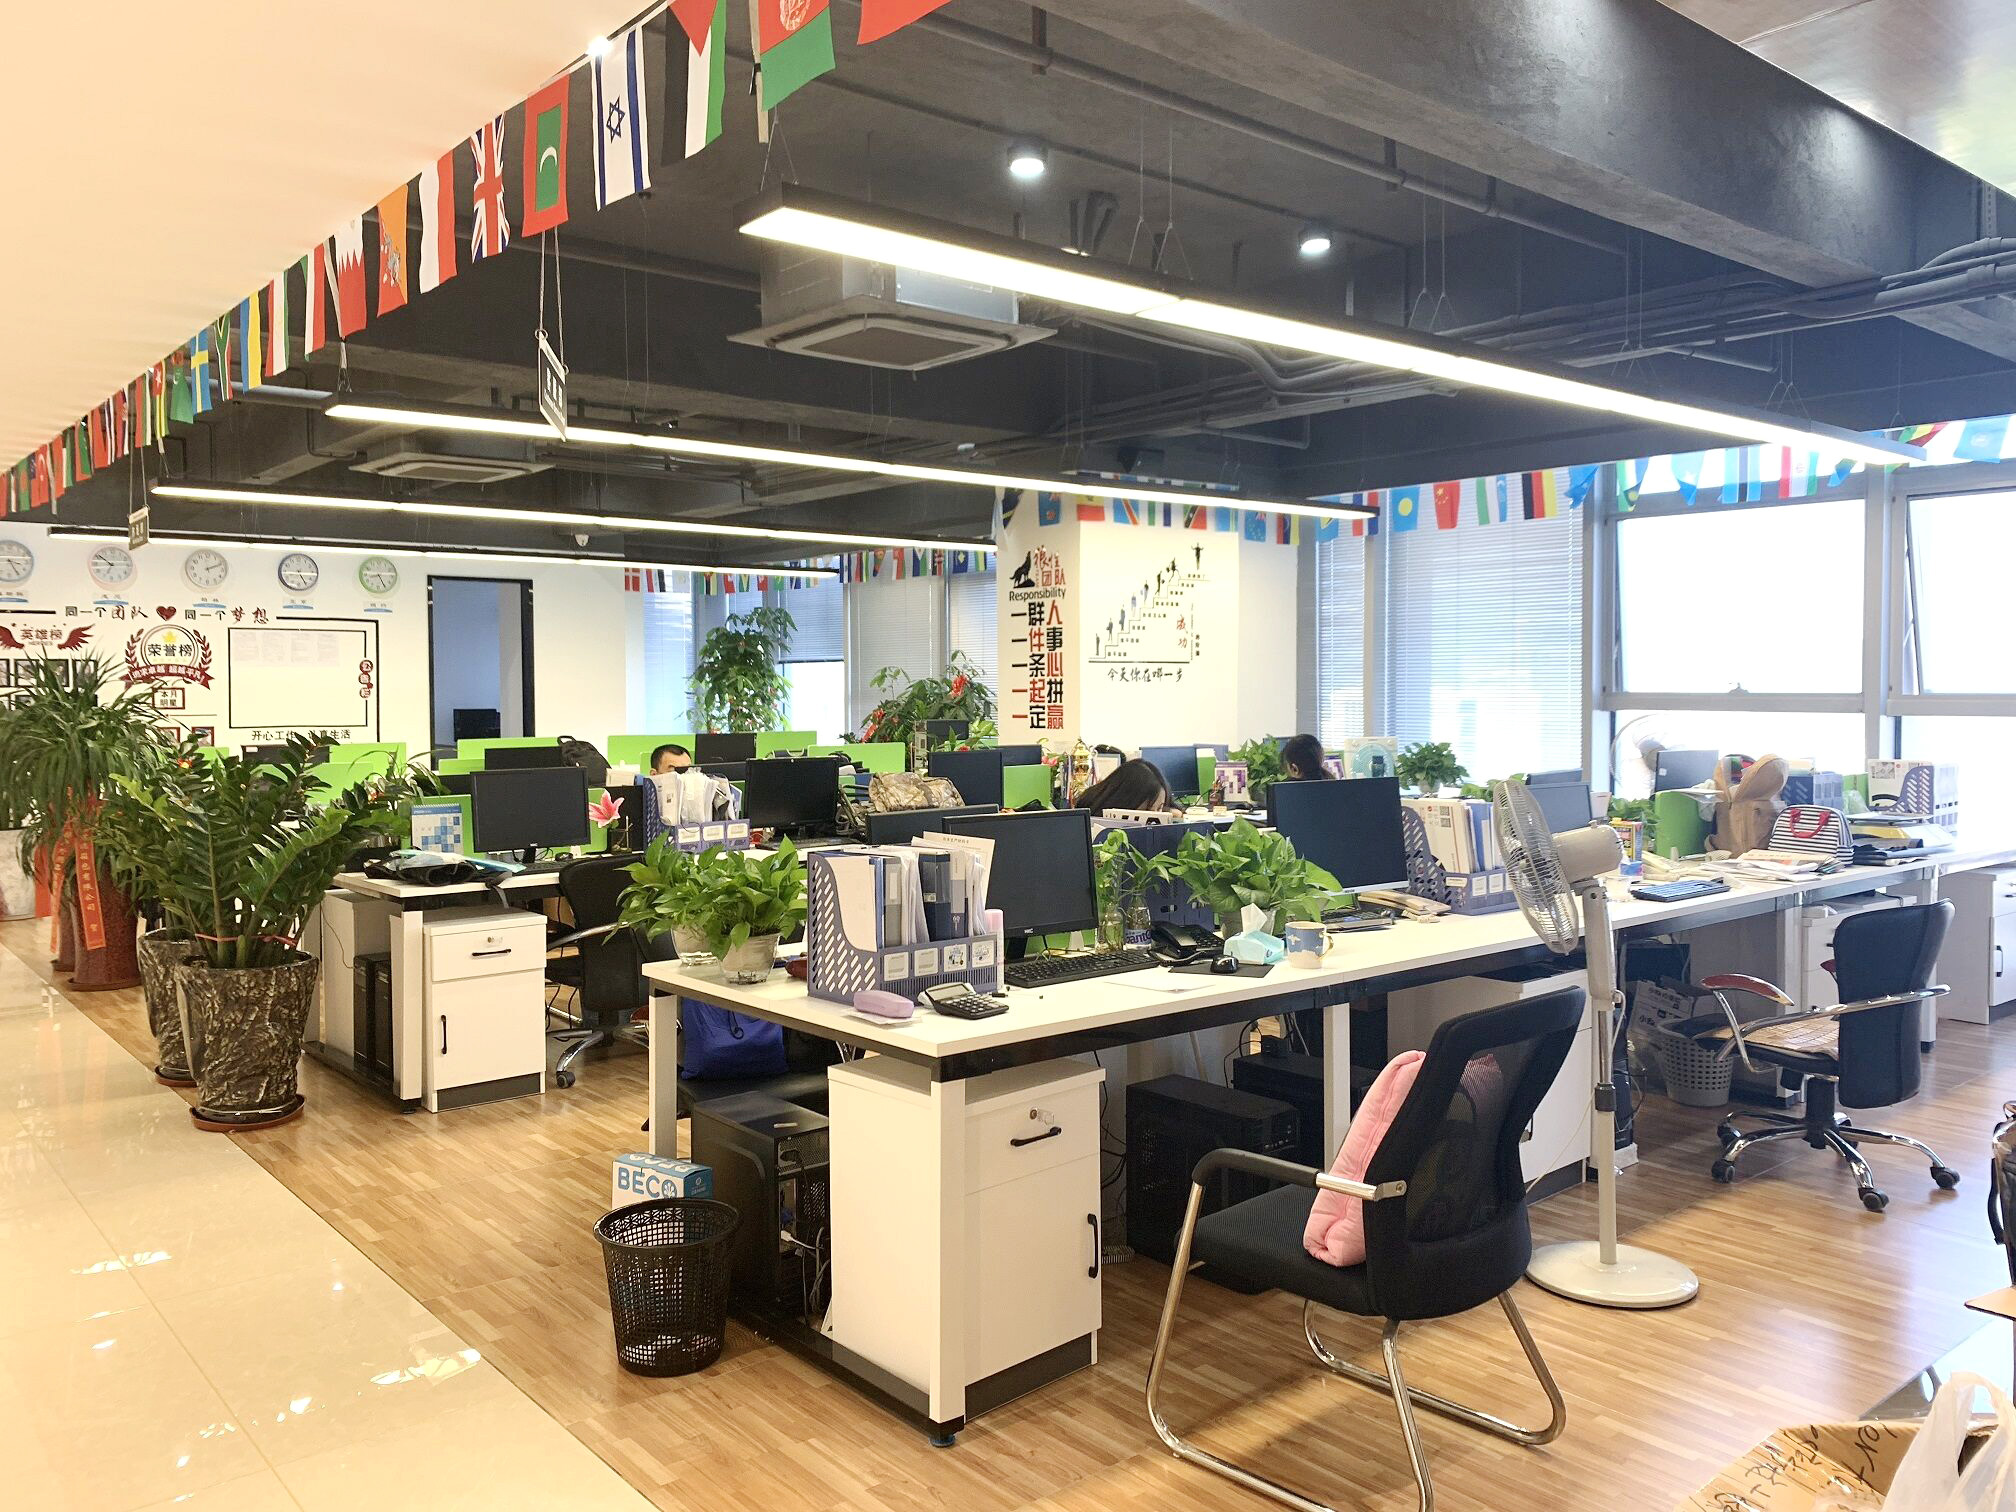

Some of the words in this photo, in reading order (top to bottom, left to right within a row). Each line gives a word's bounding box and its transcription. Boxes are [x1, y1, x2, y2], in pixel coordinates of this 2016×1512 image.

[1042, 568, 1066, 587] 团队
[1009, 587, 1067, 602] Responsibility
[1011, 600, 1063, 626] 一群人
[147, 643, 193, 657] 荣誉榜
[1011, 626, 1063, 652] 一件事
[1012, 652, 1063, 677] 一条心
[1012, 678, 1063, 703] 一起拼
[1012, 704, 1064, 729] 一定赢
[617, 1166, 678, 1199] BECO
